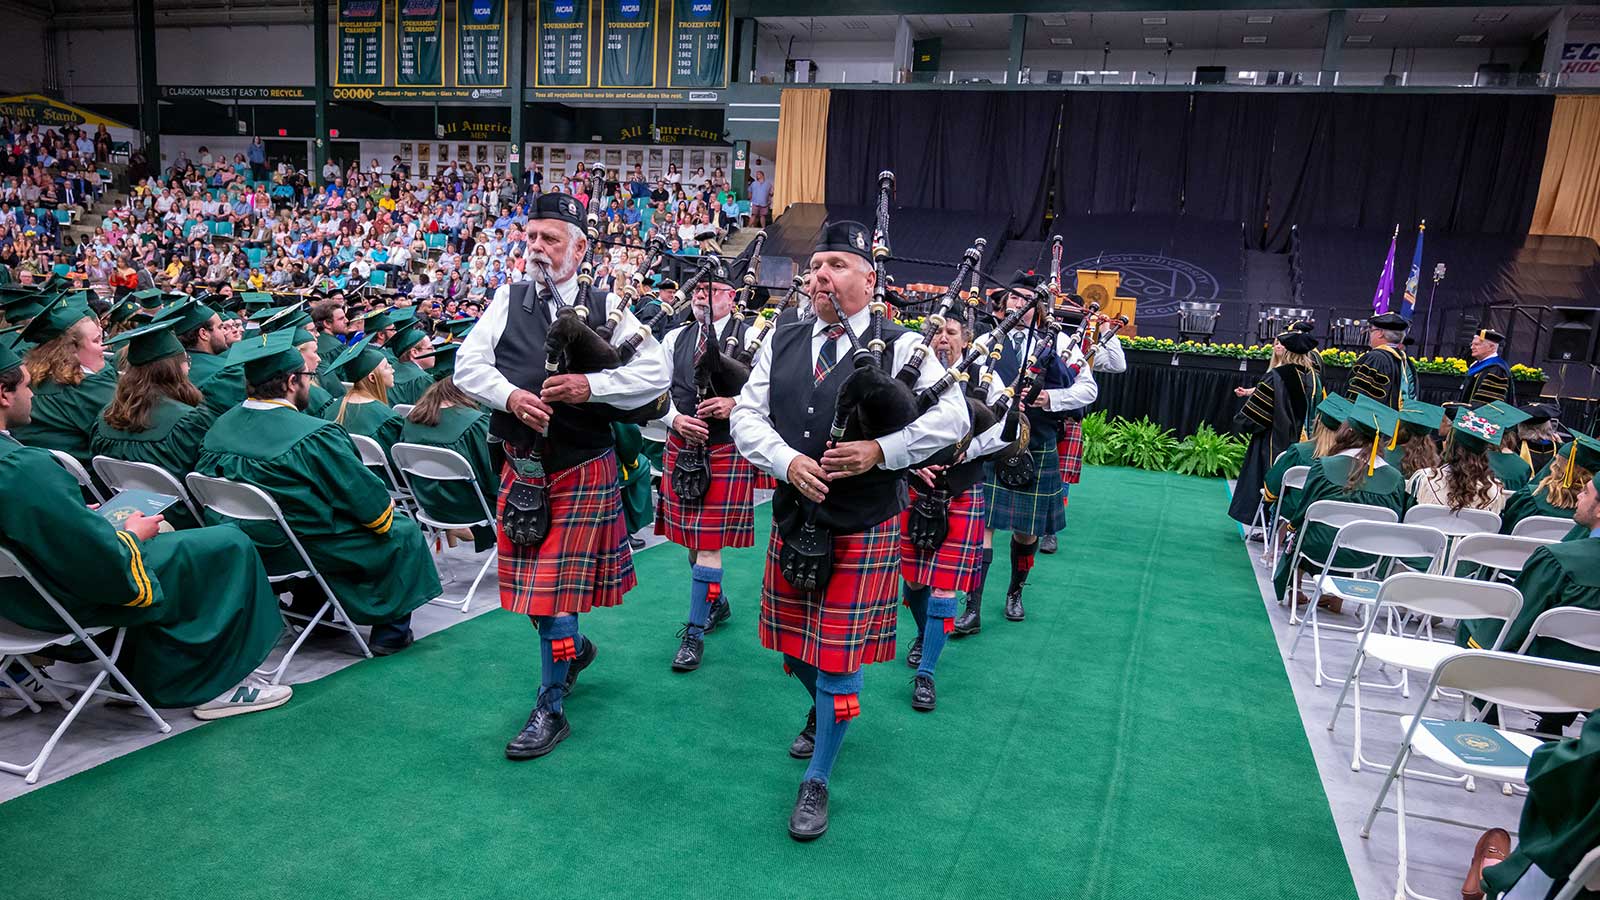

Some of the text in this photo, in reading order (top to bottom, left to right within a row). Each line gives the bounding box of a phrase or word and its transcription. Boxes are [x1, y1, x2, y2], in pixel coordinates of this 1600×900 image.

[693, 4, 712, 12] NCAA
[169, 88, 305, 97] CLARKSON MAKES IT EASY TO RECYCLE.
[43, 107, 78, 122] Stand
[620, 126, 641, 140] All
[1139, 256, 1209, 284] UNIVERSITY
[230, 686, 261, 703] N
